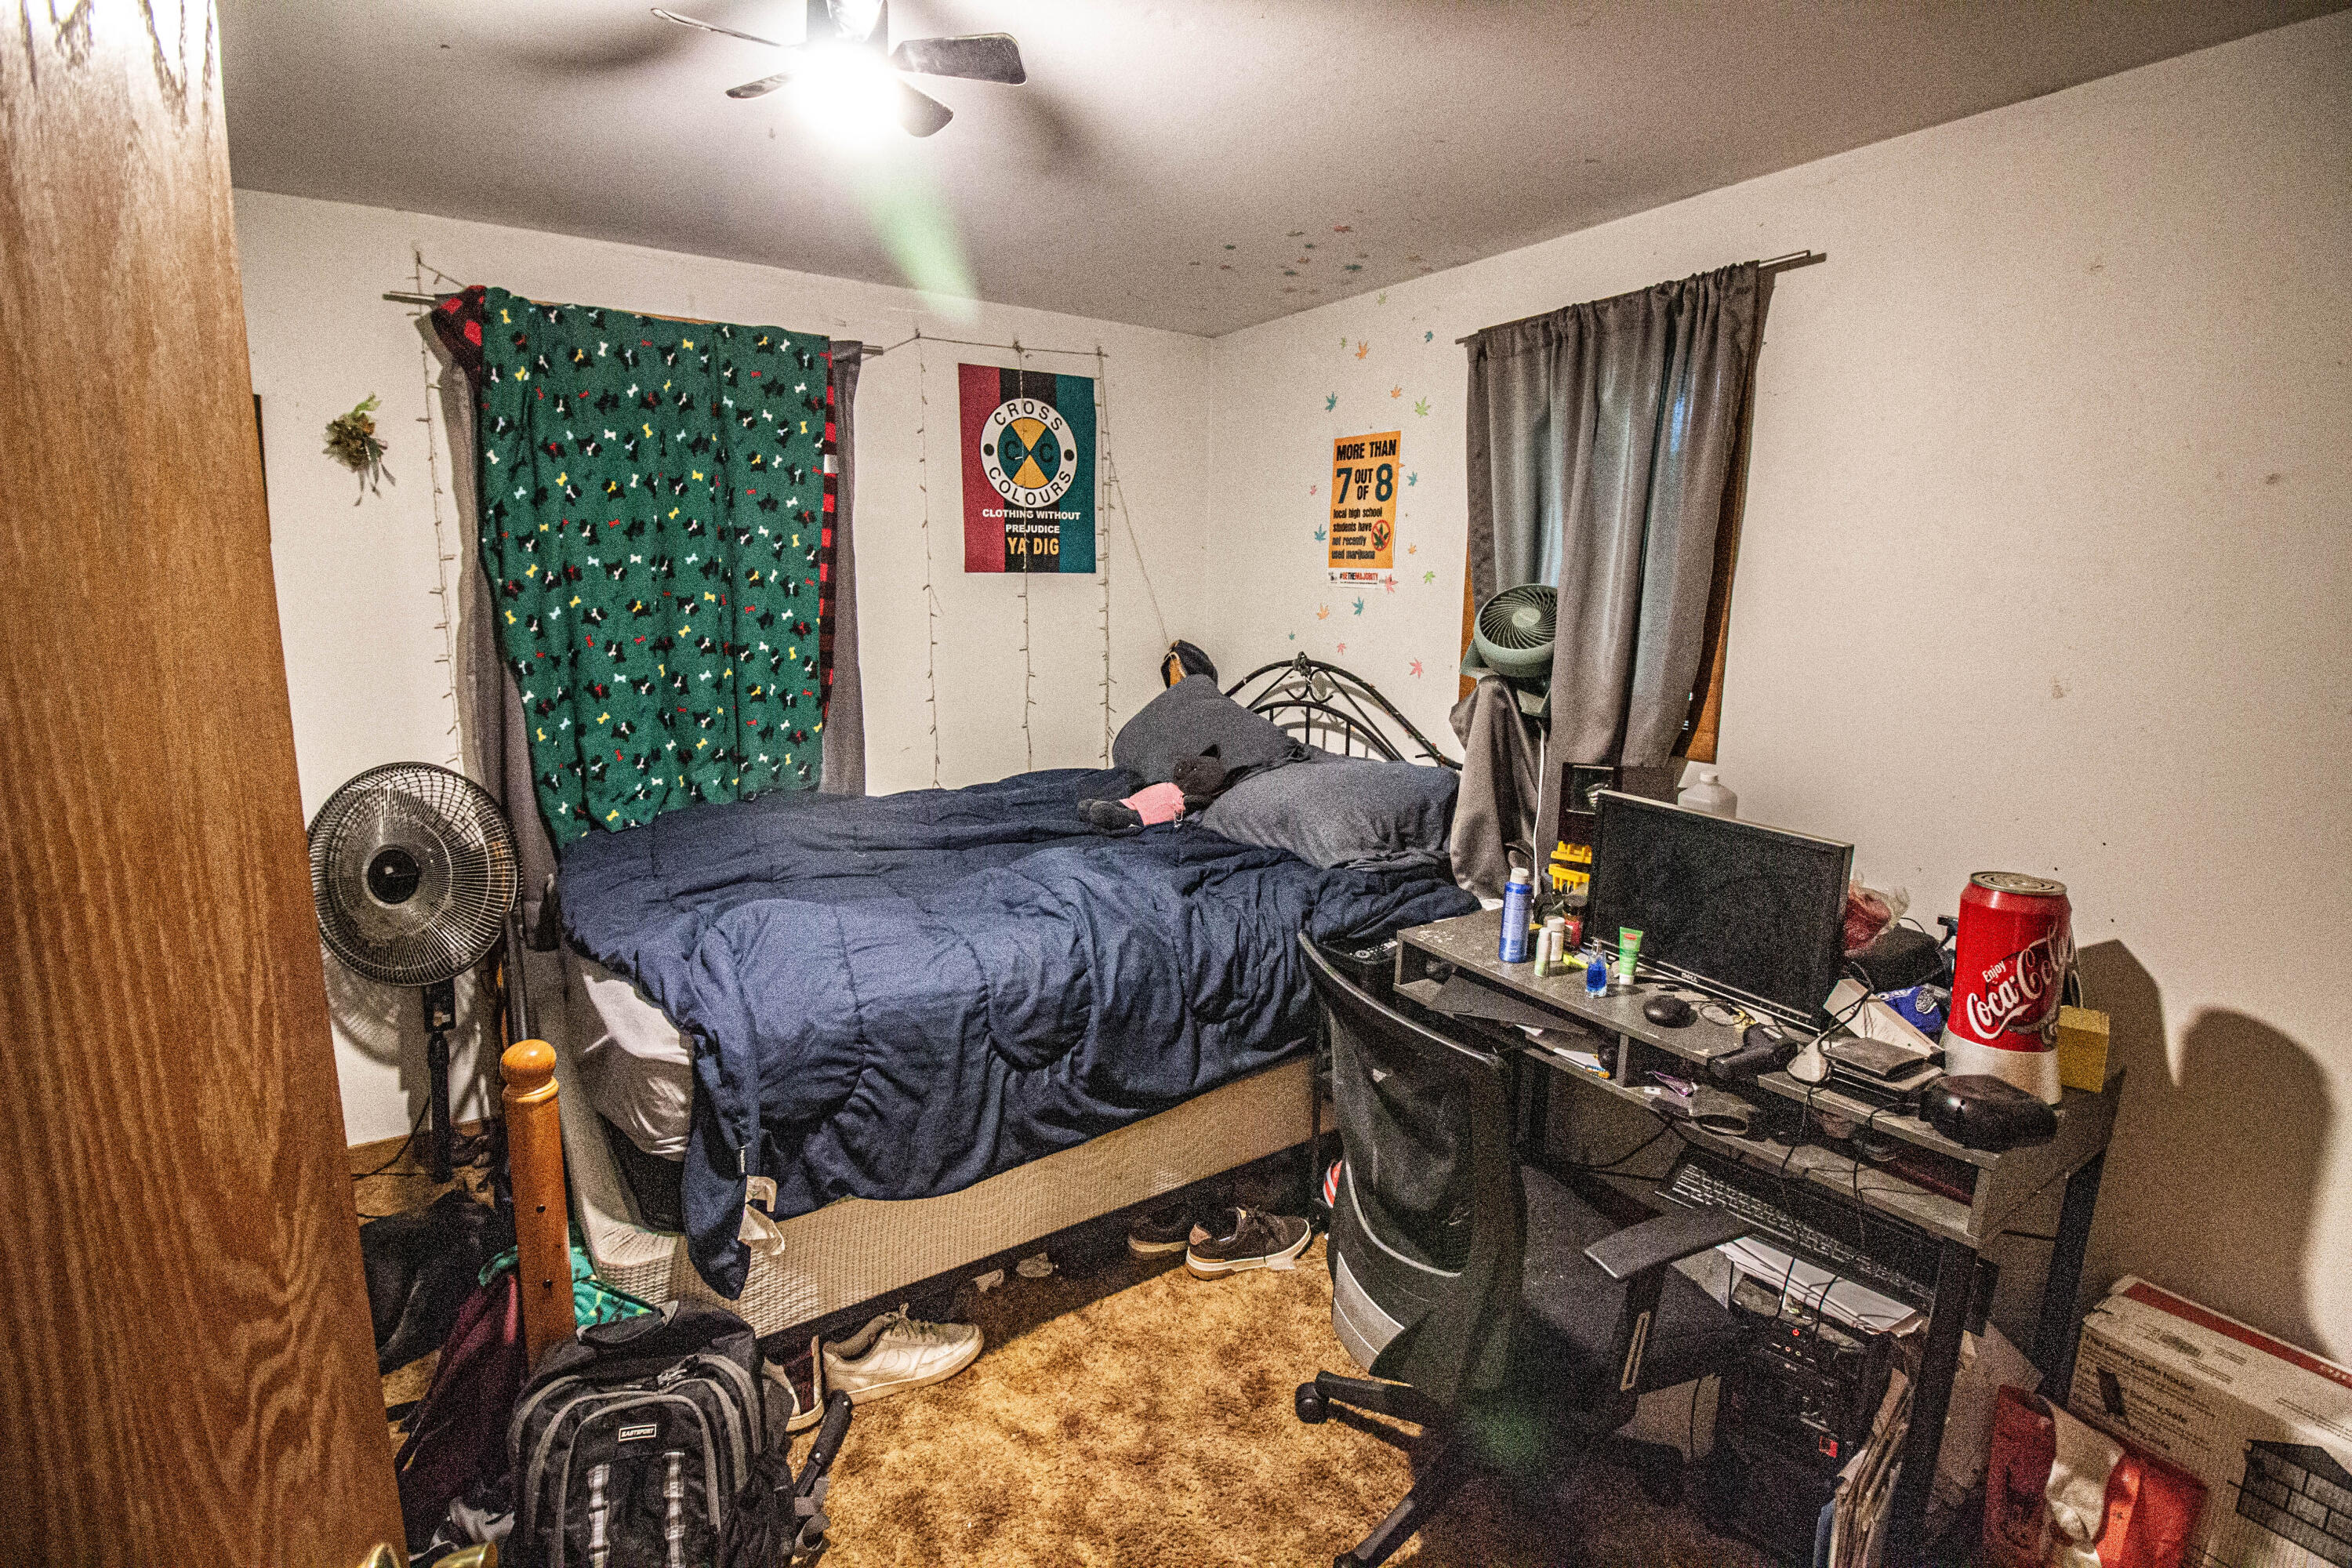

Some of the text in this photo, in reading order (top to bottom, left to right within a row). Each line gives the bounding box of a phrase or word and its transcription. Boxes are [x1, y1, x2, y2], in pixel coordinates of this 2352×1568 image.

[994, 401, 1062, 430] CROSS
[1337, 439, 1396, 461] MORE THAN
[989, 466, 1071, 505] COLOURS
[1337, 463, 1392, 503] 7 OUT OF 8
[982, 509, 1080, 520] CLOTHING WITHOUT
[1334, 507, 1382, 519] local high school
[1005, 524, 1060, 533] PREJUDICE
[1333, 522, 1372, 532] students have
[1007, 537, 1060, 555] YA DIG
[1332, 535, 1366, 546] not recently
[1332, 550, 1375, 560] used marijuana
[1983, 960, 2006, 982] Enjoy
[1681, 972, 1698, 983] DELL
